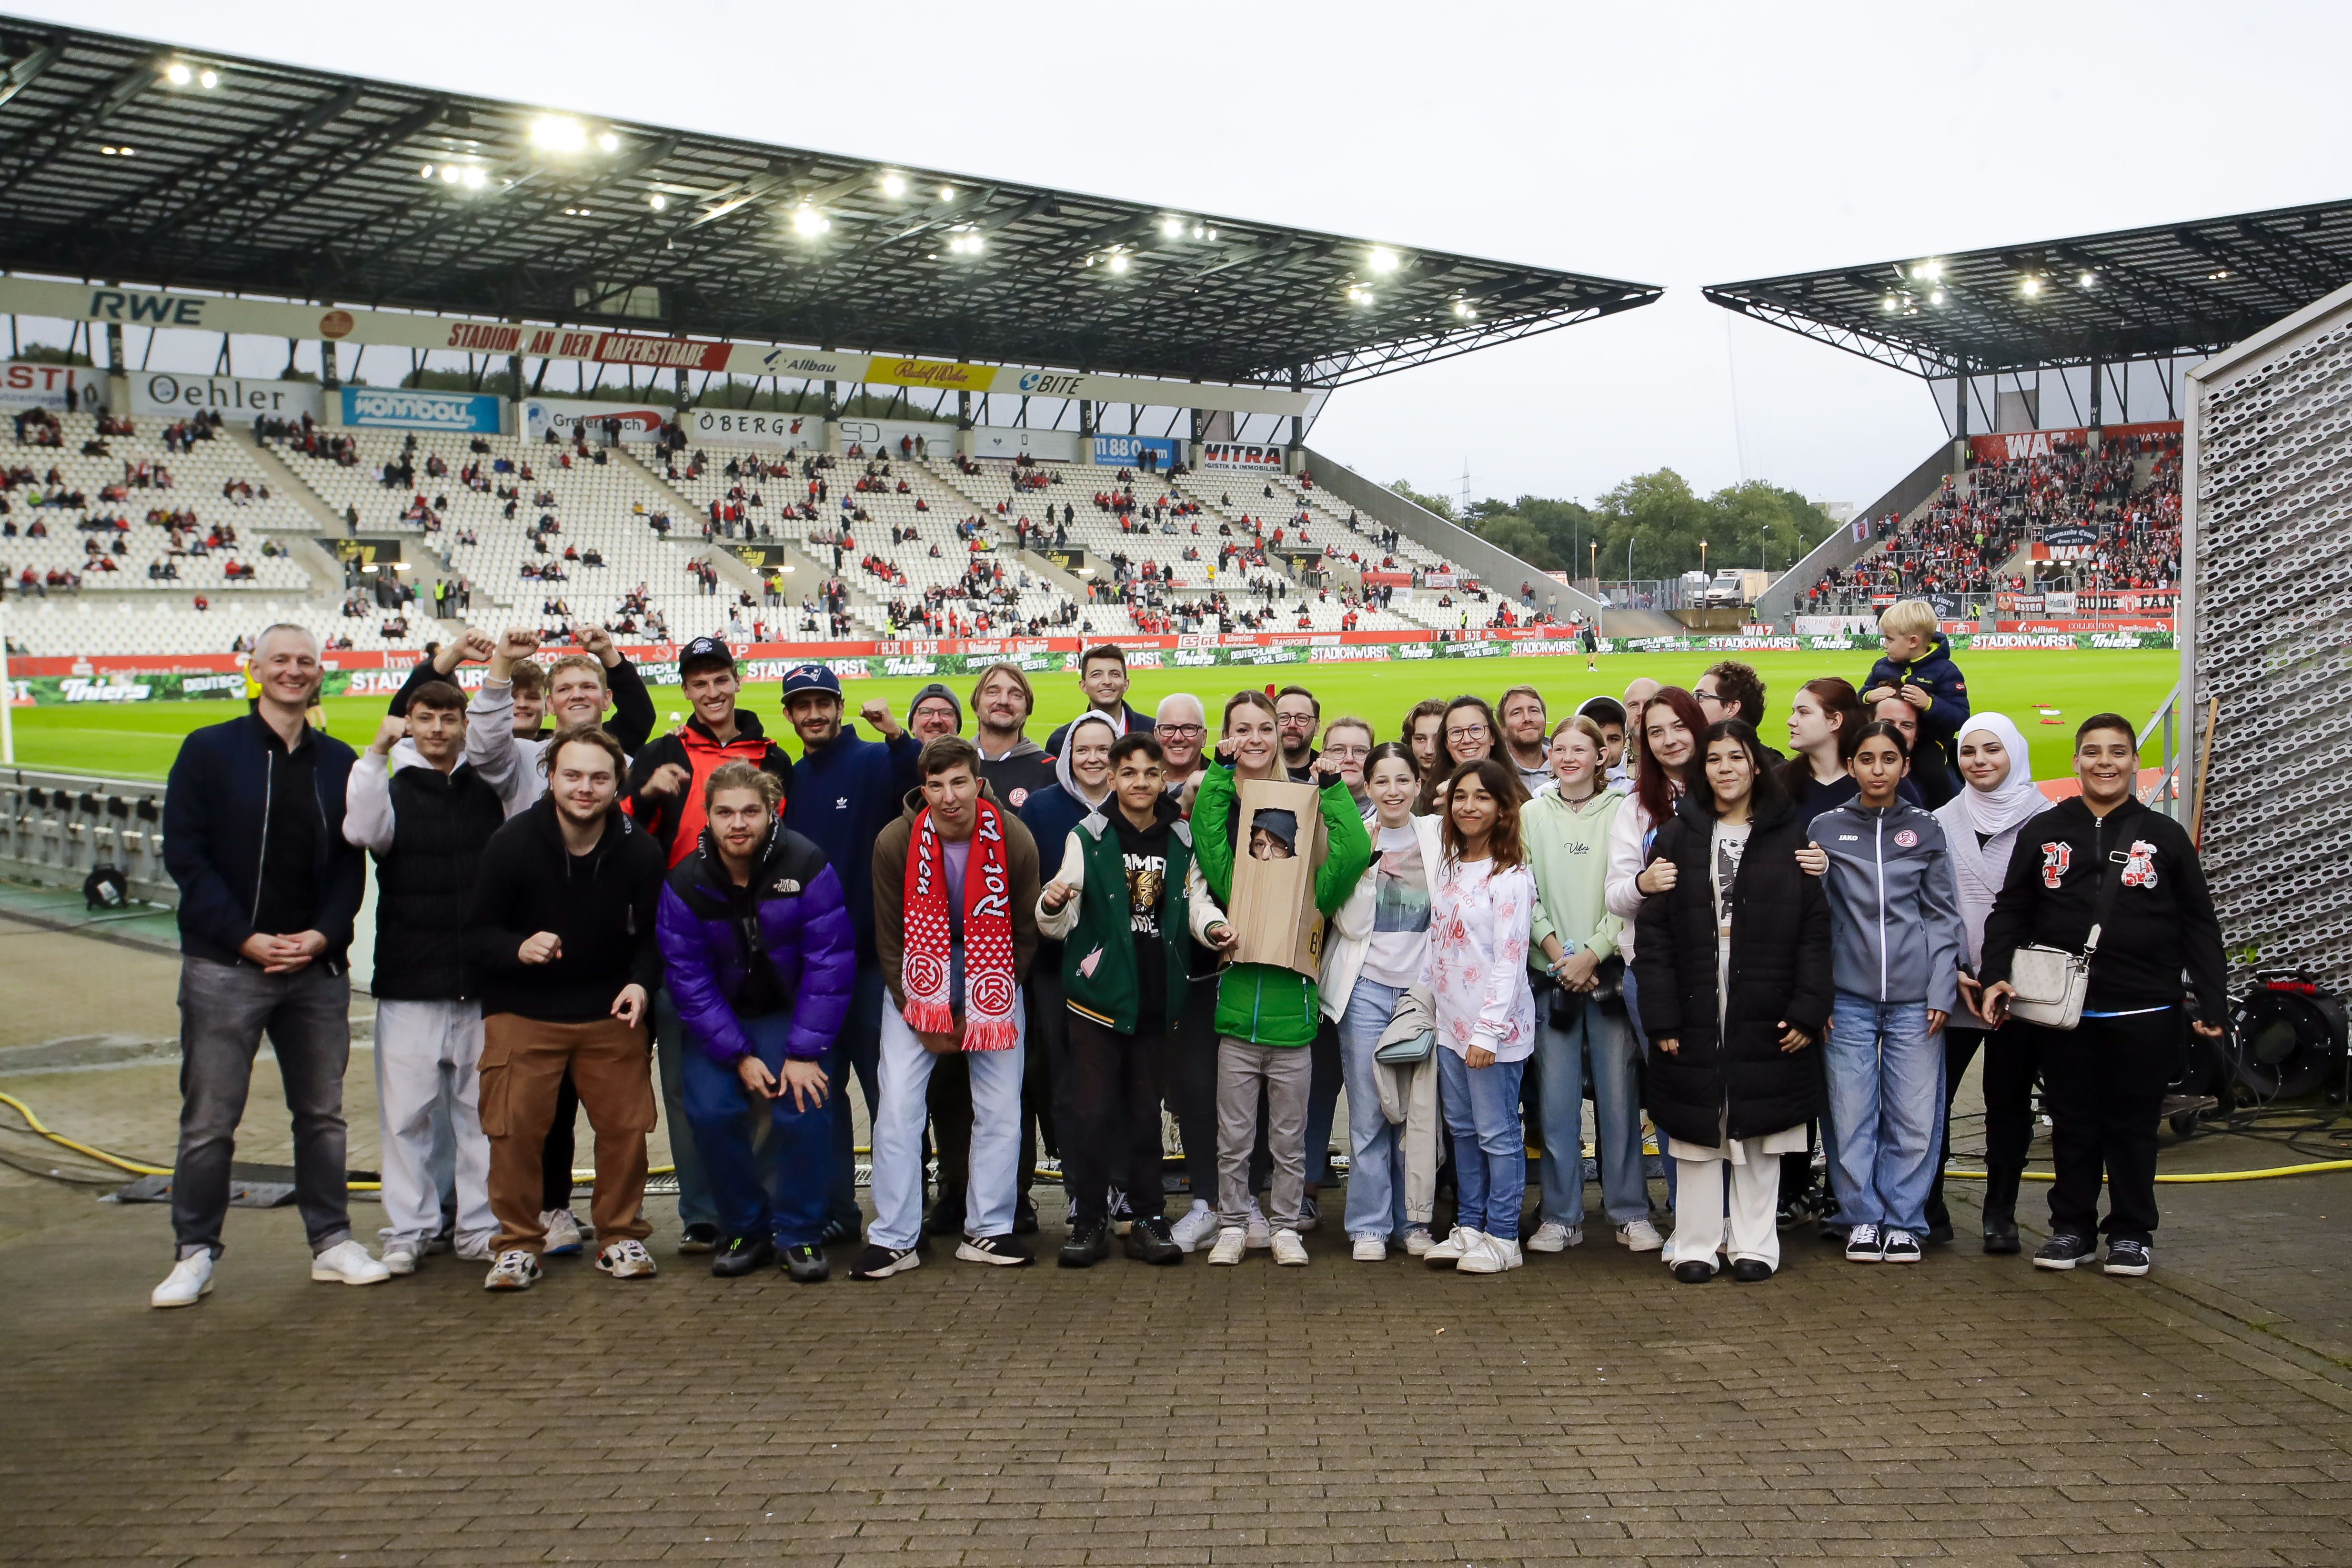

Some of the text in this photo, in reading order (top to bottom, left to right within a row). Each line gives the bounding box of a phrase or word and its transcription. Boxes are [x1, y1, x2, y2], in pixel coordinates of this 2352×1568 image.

[90, 291, 206, 325] RWE
[448, 322, 521, 352] STADION
[529, 330, 555, 354] AN
[559, 332, 593, 357] DER
[787, 360, 837, 373] Allbau
[0, 366, 76, 391] STI
[1037, 375, 1085, 394] BITE
[149, 374, 284, 411] Oehler
[700, 411, 784, 436] ÖBERG
[2078, 595, 2119, 610] RUDE
[2141, 593, 2181, 609] FAN
[1465, 631, 1481, 641] HJE
[1743, 625, 1773, 635] WAZ
[1446, 640, 1489, 653] DEUTSCHLANDS
[1511, 641, 1577, 653] STADIONWURST
[1628, 636, 1674, 648] DEUTSCHLANDS
[1709, 637, 1799, 649] STADIONWURST
[1811, 636, 1853, 649] Thiers
[1972, 634, 2075, 647] STADIONWURST
[2091, 634, 2141, 648] Thiers
[882, 642, 901, 655] HJE
[912, 641, 939, 654] HJE
[1231, 646, 1283, 660] DEUTSCHLANDS
[1311, 645, 1389, 660] STADIONWURST
[1399, 644, 1434, 659] Thiers
[1464, 646, 1500, 658] WOHL BESTE
[1022, 658, 1049, 671] BESTE
[1175, 650, 1216, 666] Thiers
[1253, 652, 1297, 665] WOHL BESTE
[885, 658, 937, 675] Thiers
[60, 678, 151, 702] Thiers
[1564, 841, 1590, 853] Vibes
[1451, 885, 1476, 908] PERFECT
